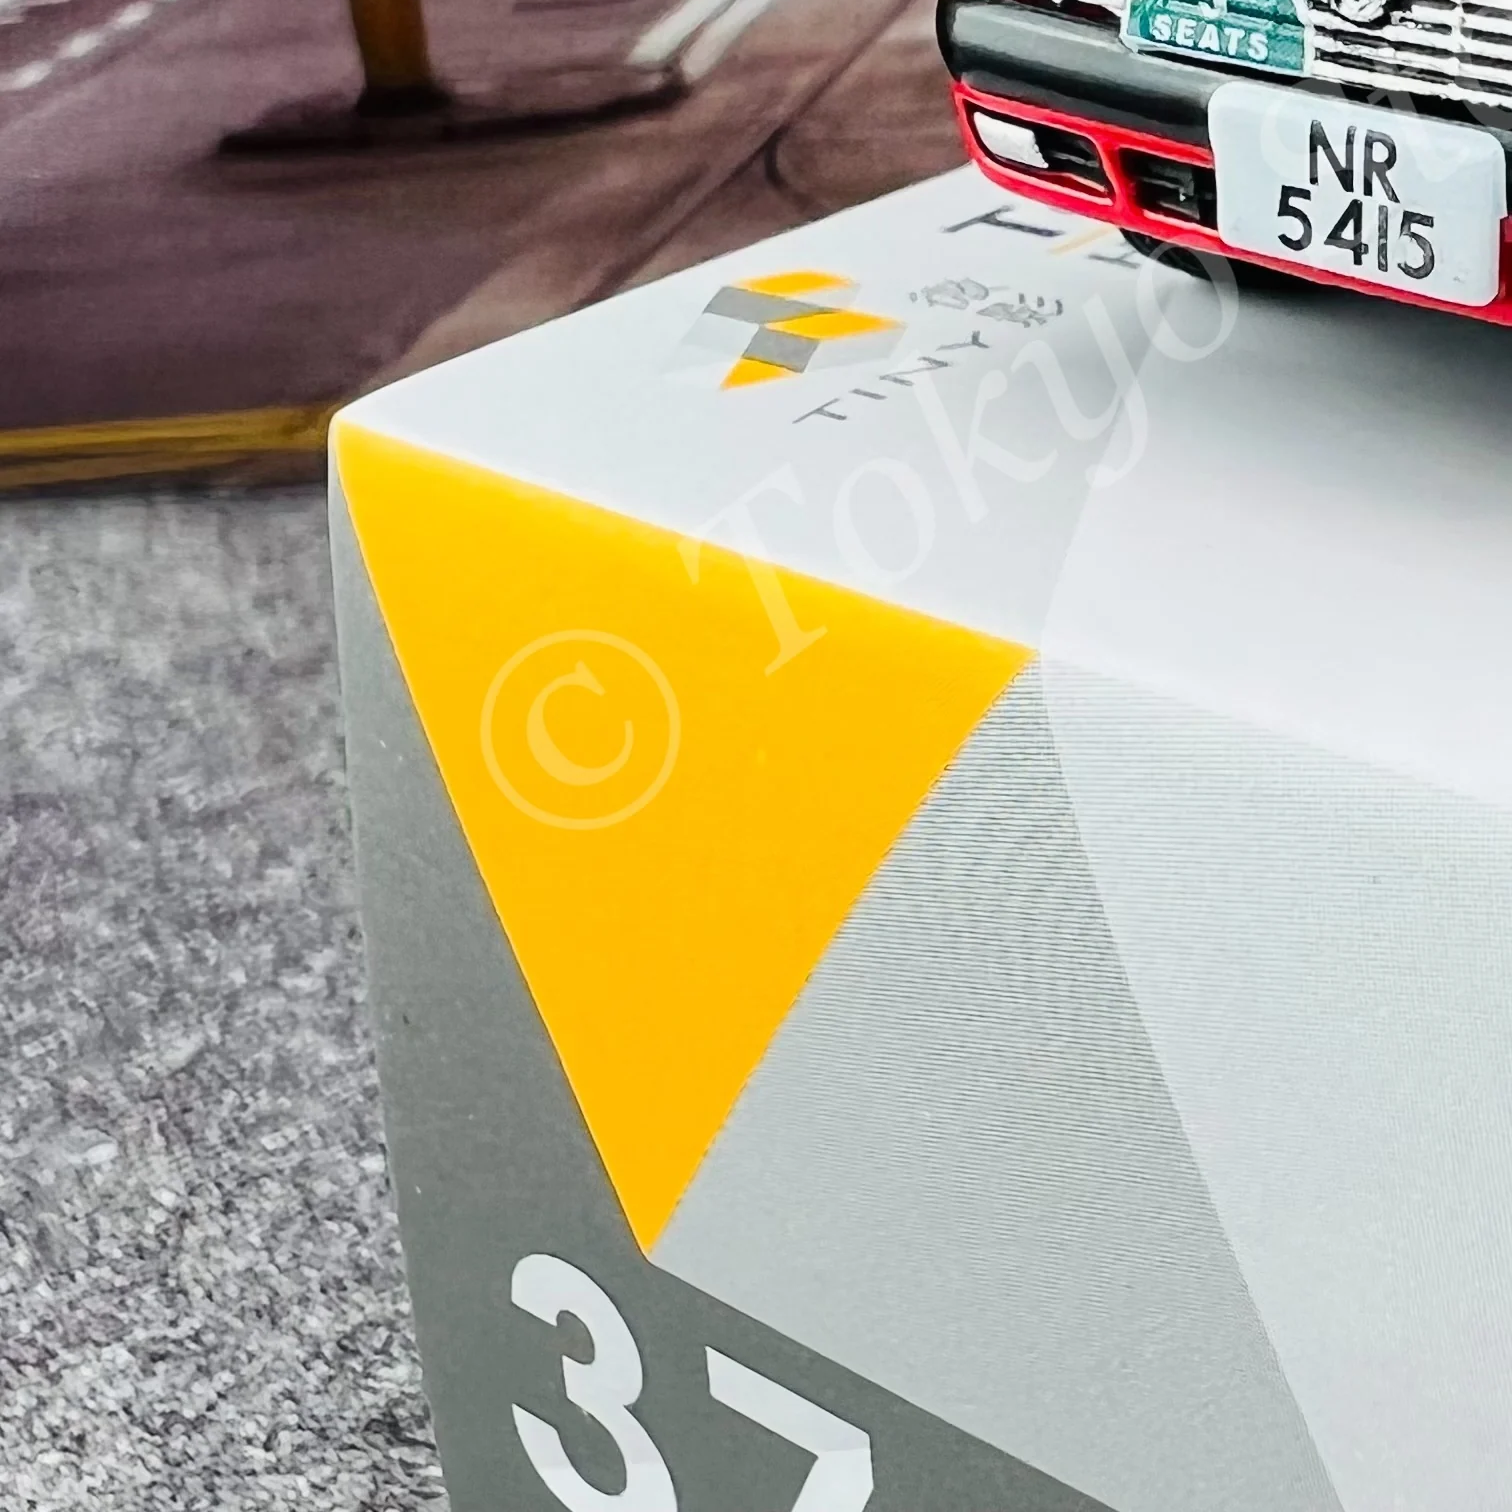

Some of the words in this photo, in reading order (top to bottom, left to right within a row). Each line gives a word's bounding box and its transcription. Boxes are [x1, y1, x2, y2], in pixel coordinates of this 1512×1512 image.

[1151, 13, 1270, 63] SEATS
[1308, 119, 1401, 204] NR
[1276, 184, 1436, 280] 5415
[792, 329, 990, 424] TINY
[511, 1253, 875, 1512] 37
